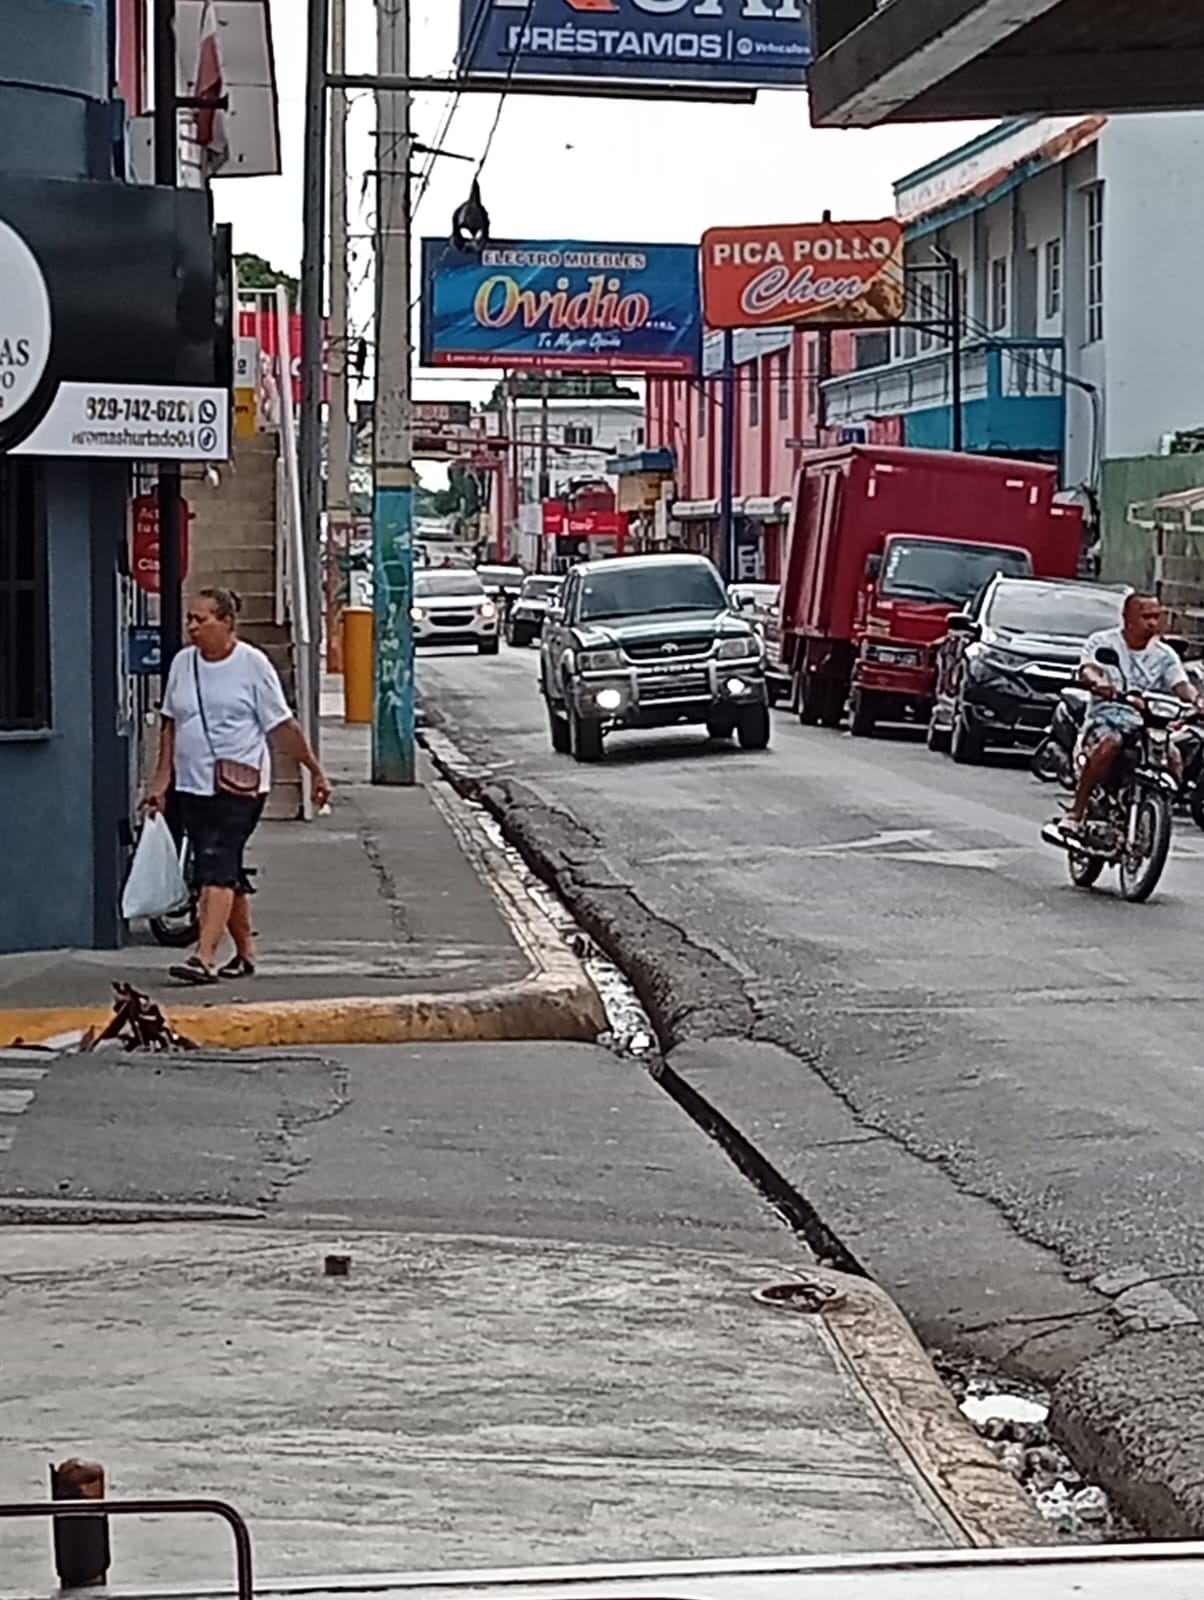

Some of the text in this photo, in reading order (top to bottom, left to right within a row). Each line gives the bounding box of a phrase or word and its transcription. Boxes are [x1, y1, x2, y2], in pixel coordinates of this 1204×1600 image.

[508, 22, 722, 58] PRÉSTAMOS
[482, 250, 647, 270] ELECTRO MUEBLES
[713, 237, 891, 266] PICA POLLO
[474, 274, 649, 332] Ovidio
[741, 264, 864, 315] Chen
[0, 337, 30, 367] AS
